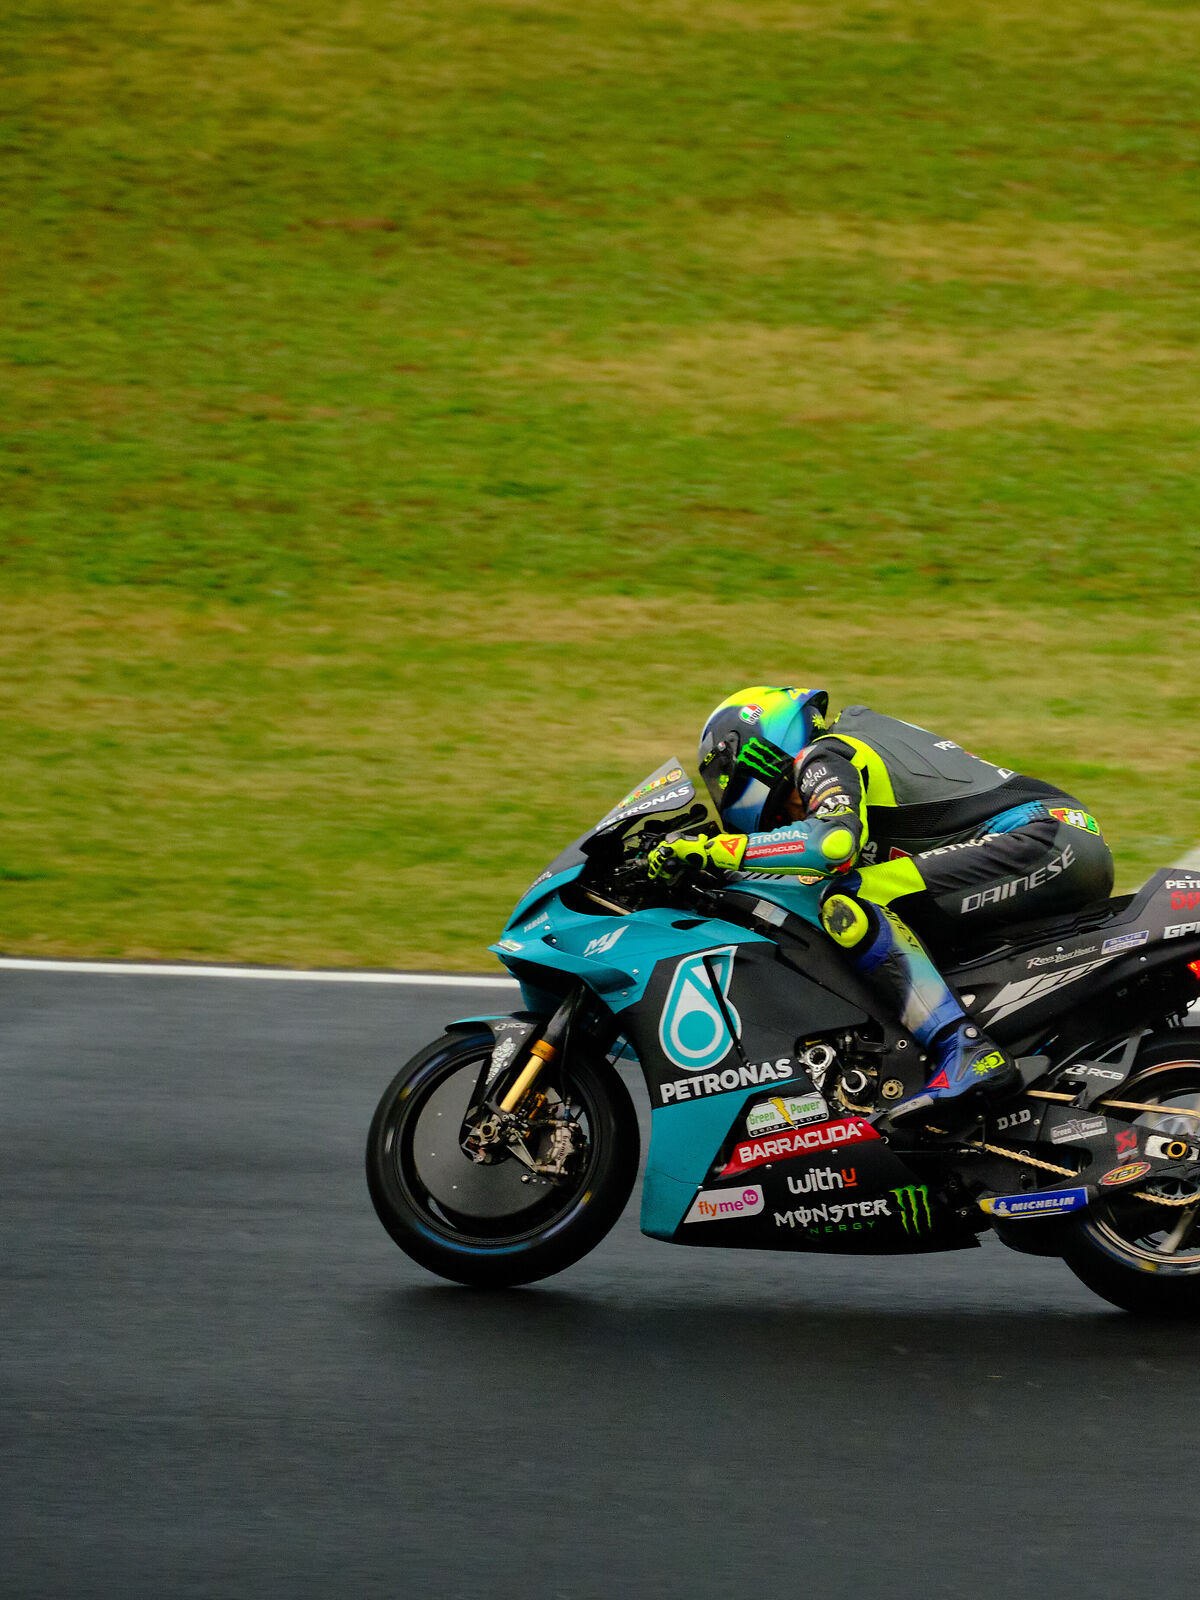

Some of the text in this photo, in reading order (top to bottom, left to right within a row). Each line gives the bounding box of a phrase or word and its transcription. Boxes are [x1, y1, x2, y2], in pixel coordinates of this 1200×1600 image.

[748, 830, 809, 846] ETRONAS
[960, 843, 1077, 914] DAINESE
[659, 1057, 794, 1104] PETRONAS
[1086, 1067, 1125, 1080] RCB
[748, 1100, 821, 1126] Green Power
[738, 1122, 863, 1164] BARRACUDA
[1010, 1197, 1076, 1213] MICHELIN
